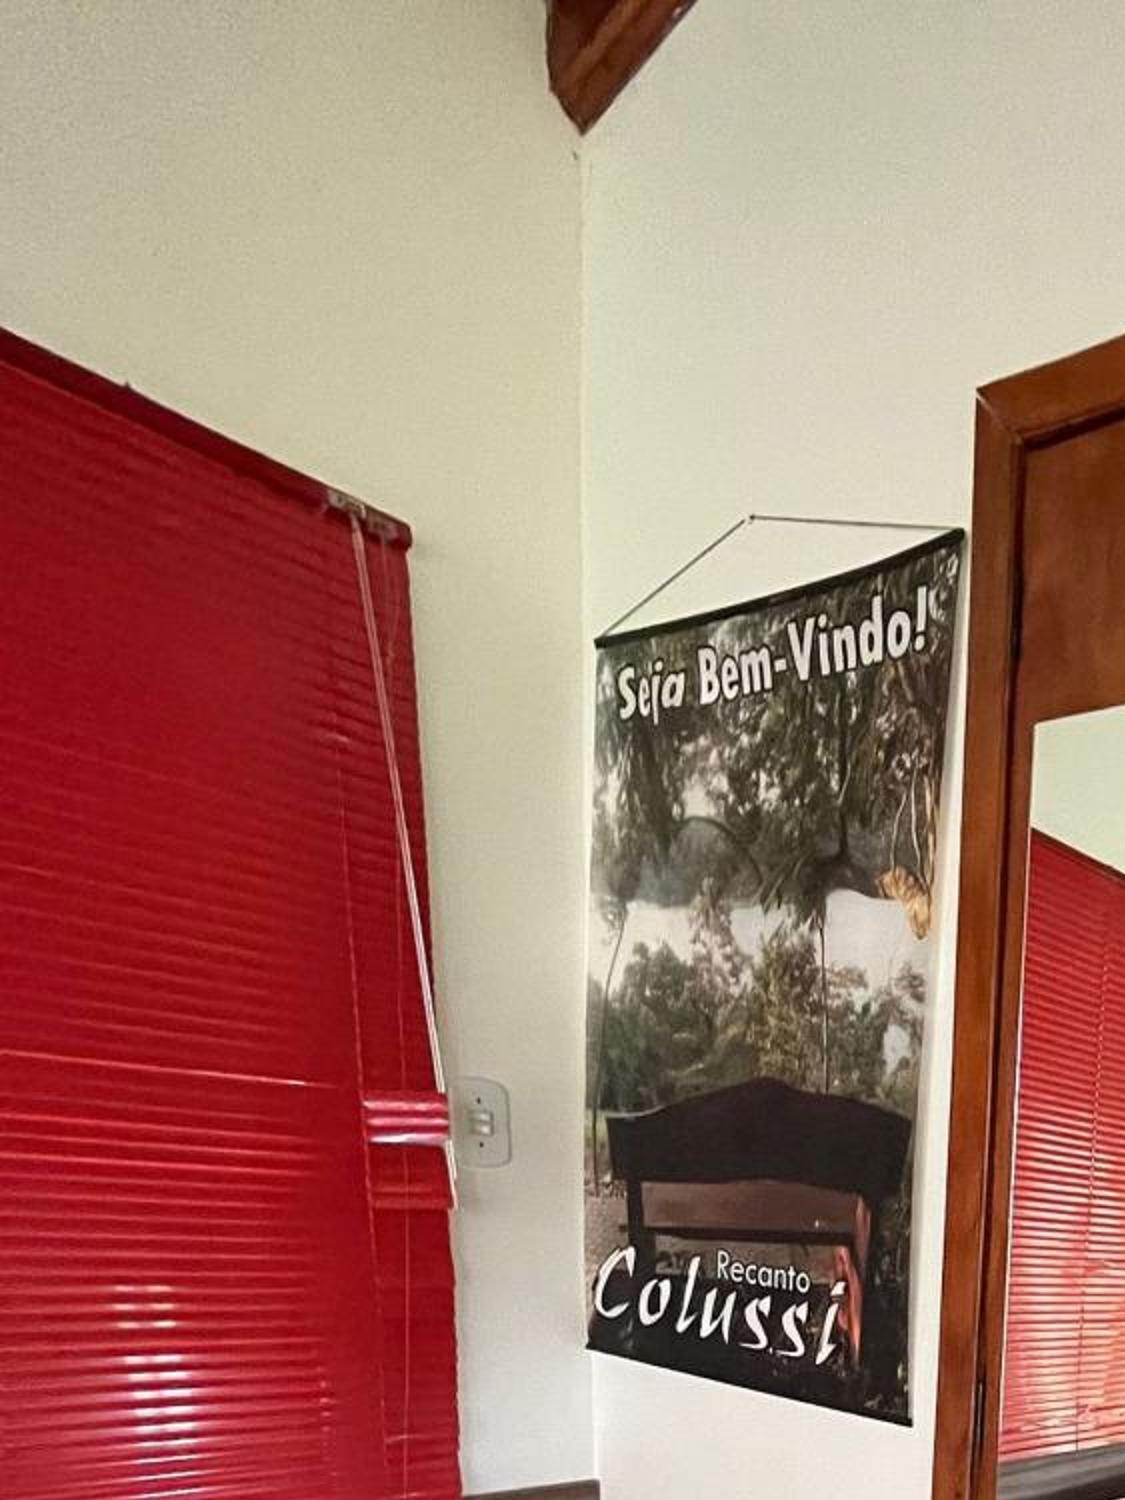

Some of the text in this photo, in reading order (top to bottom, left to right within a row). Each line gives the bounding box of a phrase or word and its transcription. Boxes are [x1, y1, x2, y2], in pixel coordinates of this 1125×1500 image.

[618, 585, 928, 726] Seja Bem-Vindo!
[594, 1245, 847, 1366] Colussi
[715, 1249, 812, 1294] Recanto
